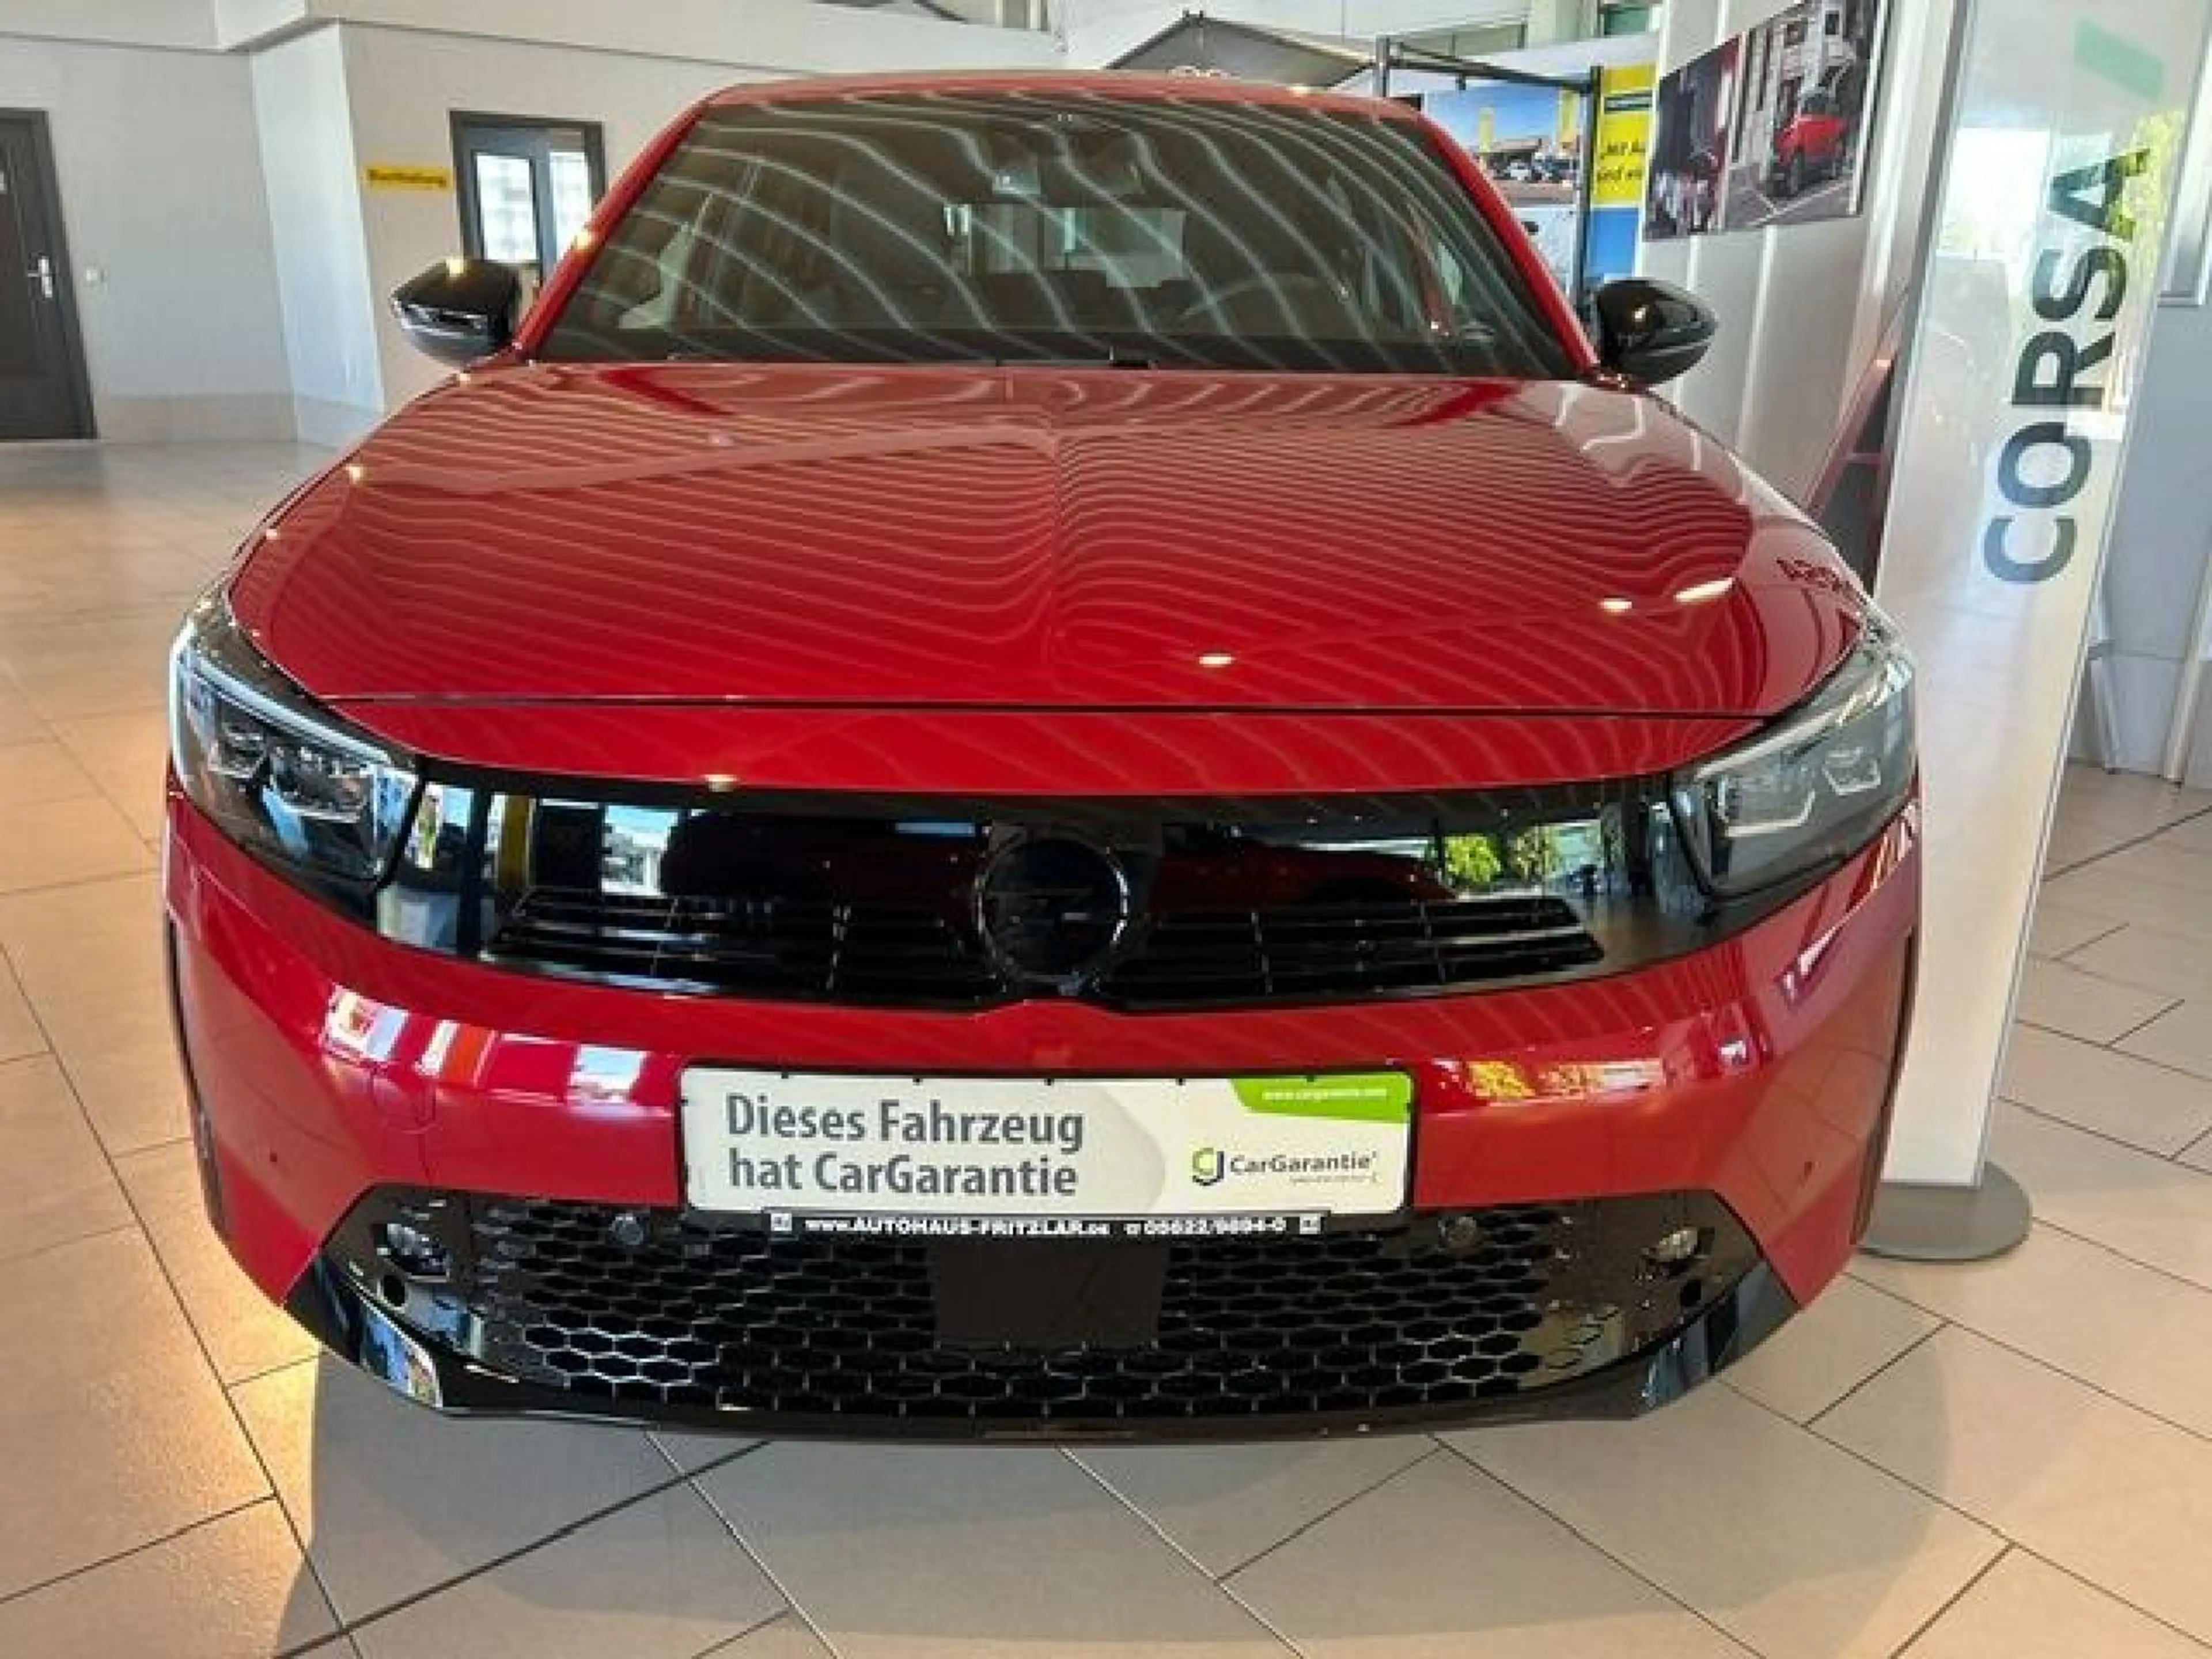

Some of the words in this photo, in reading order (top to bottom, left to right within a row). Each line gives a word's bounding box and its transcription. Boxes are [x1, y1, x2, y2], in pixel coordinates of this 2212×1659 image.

[1984, 149, 2150, 584] CORSA
[726, 1093, 866, 1139] Dieses
[879, 1099, 1085, 1154] Fahrzeug
[728, 1148, 803, 1190] hat
[815, 1152, 1078, 1196] CarGarantie
[1230, 1151, 1372, 1173] CarGarantie
